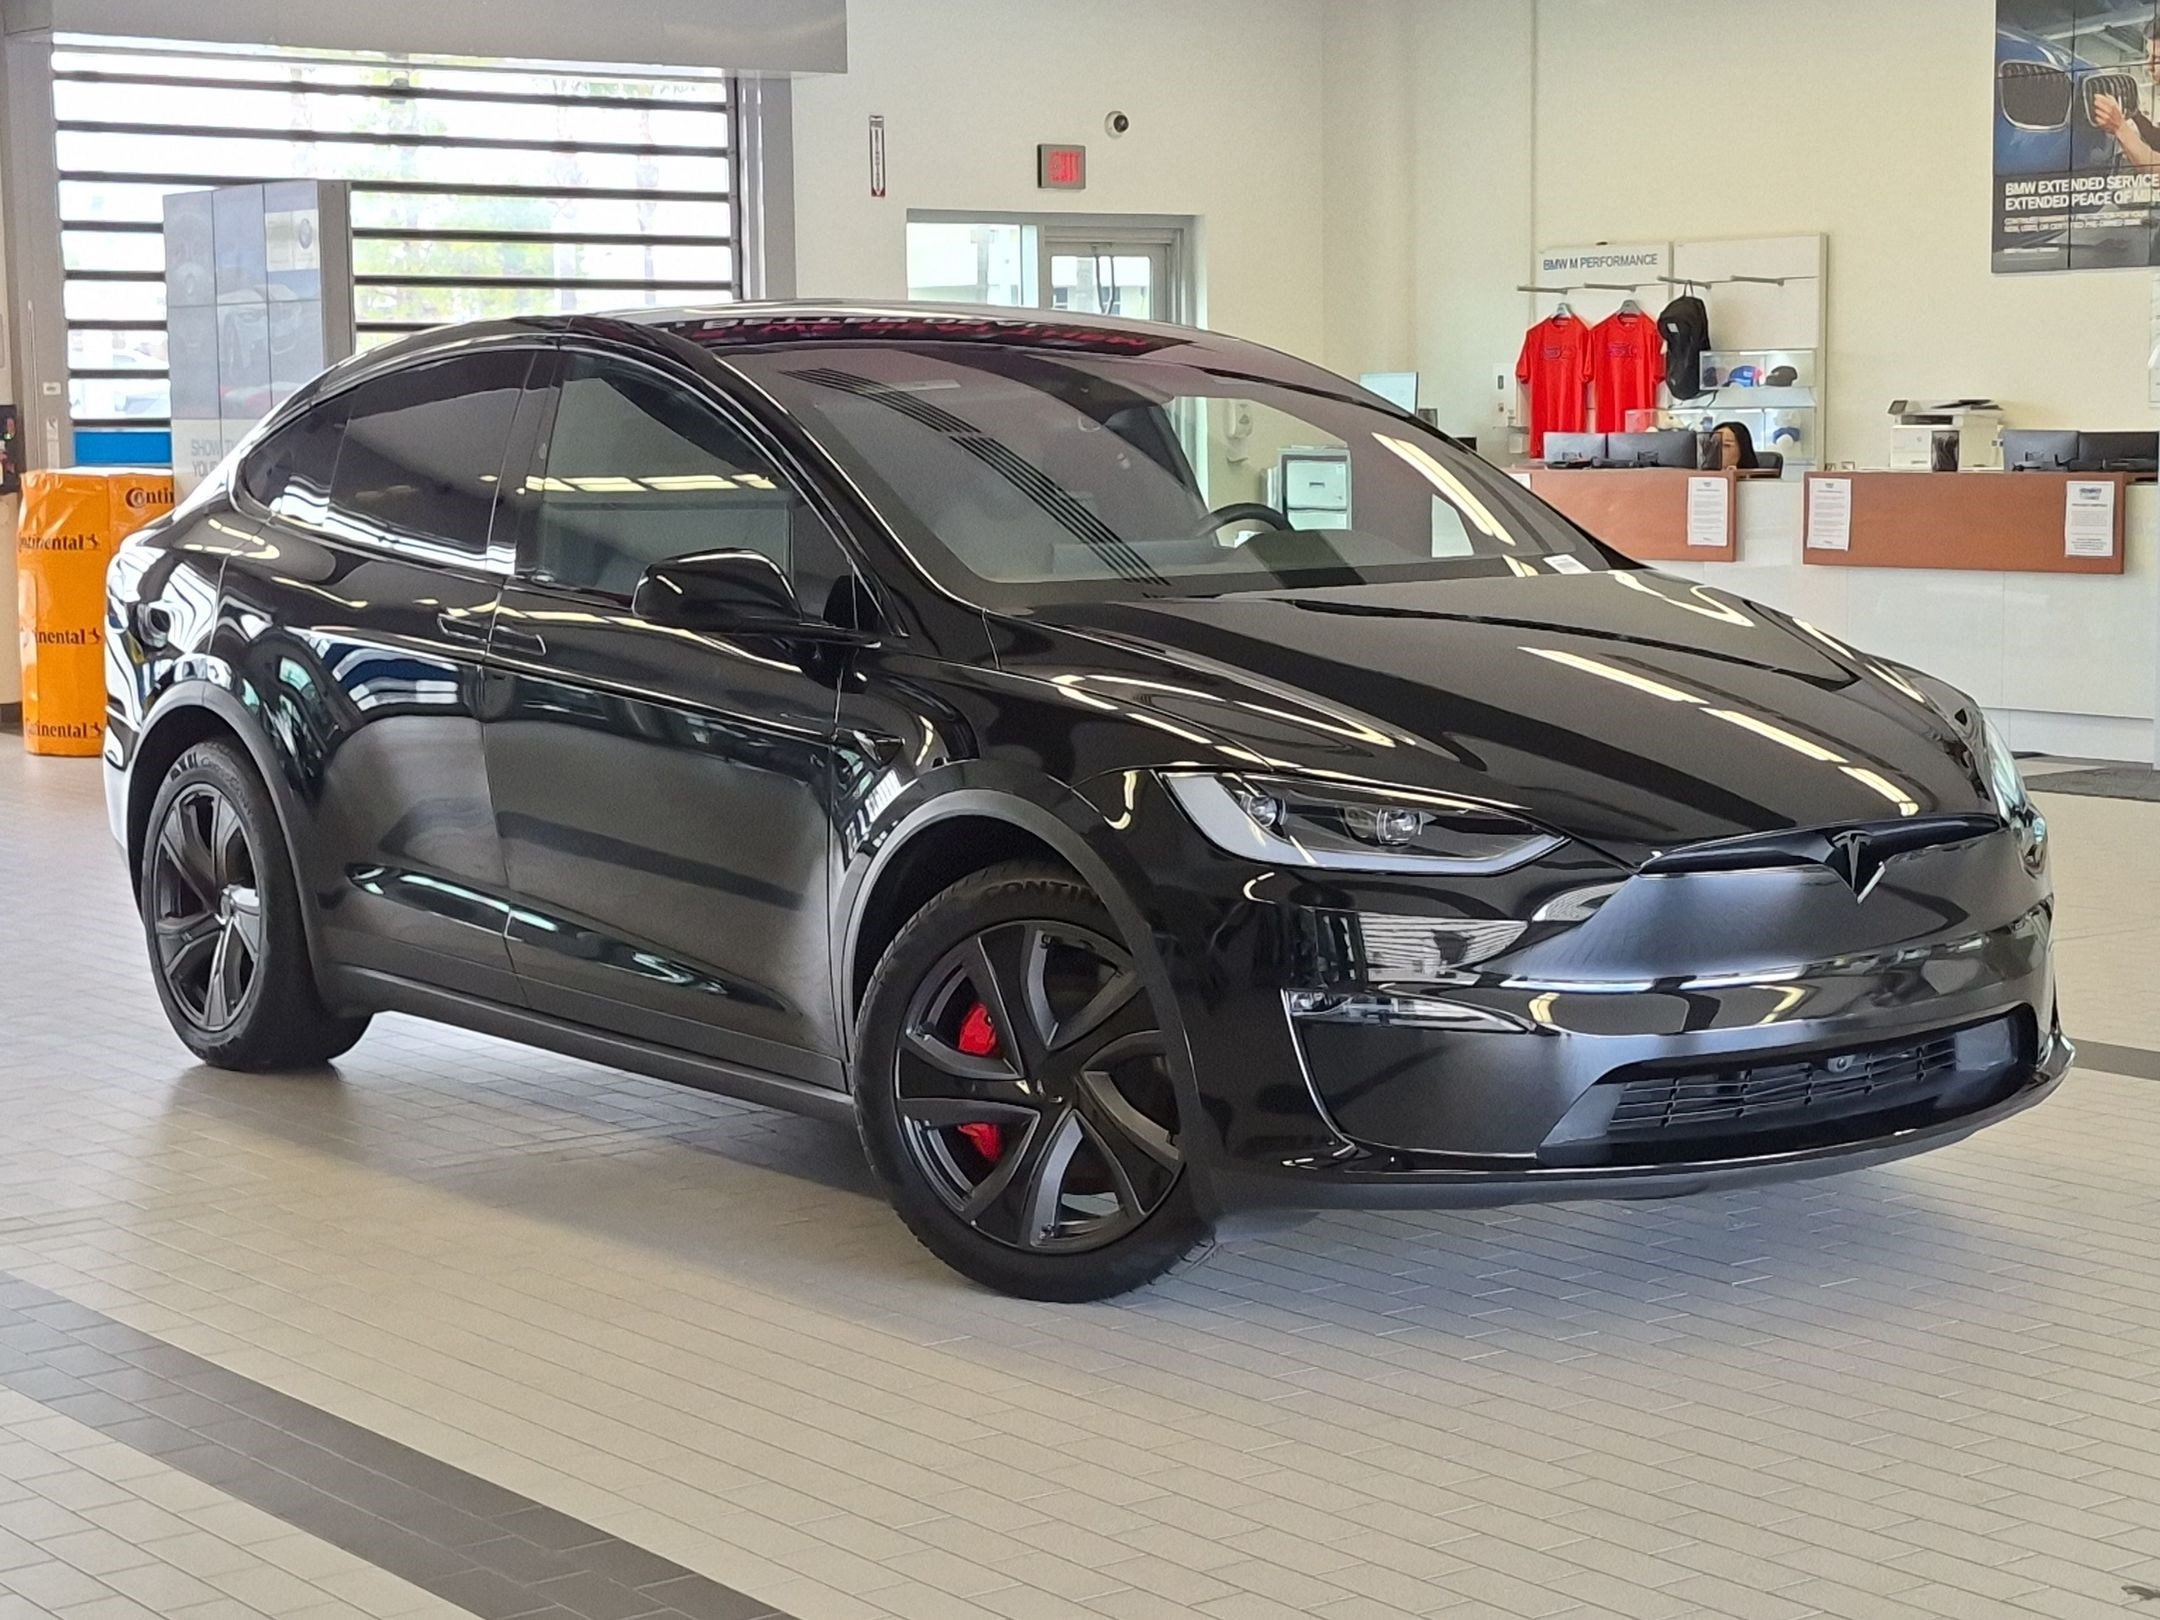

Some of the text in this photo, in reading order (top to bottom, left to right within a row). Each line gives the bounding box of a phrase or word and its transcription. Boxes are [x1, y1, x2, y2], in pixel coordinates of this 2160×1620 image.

[2005, 173, 2159, 196] BMW EXTENDED SERVICE
[2005, 194, 2069, 211] EXTENDED
[2071, 190, 2112, 207] PEACE
[2113, 189, 2131, 205] OF
[1543, 252, 1658, 271] BMW M PERFORMANCE
